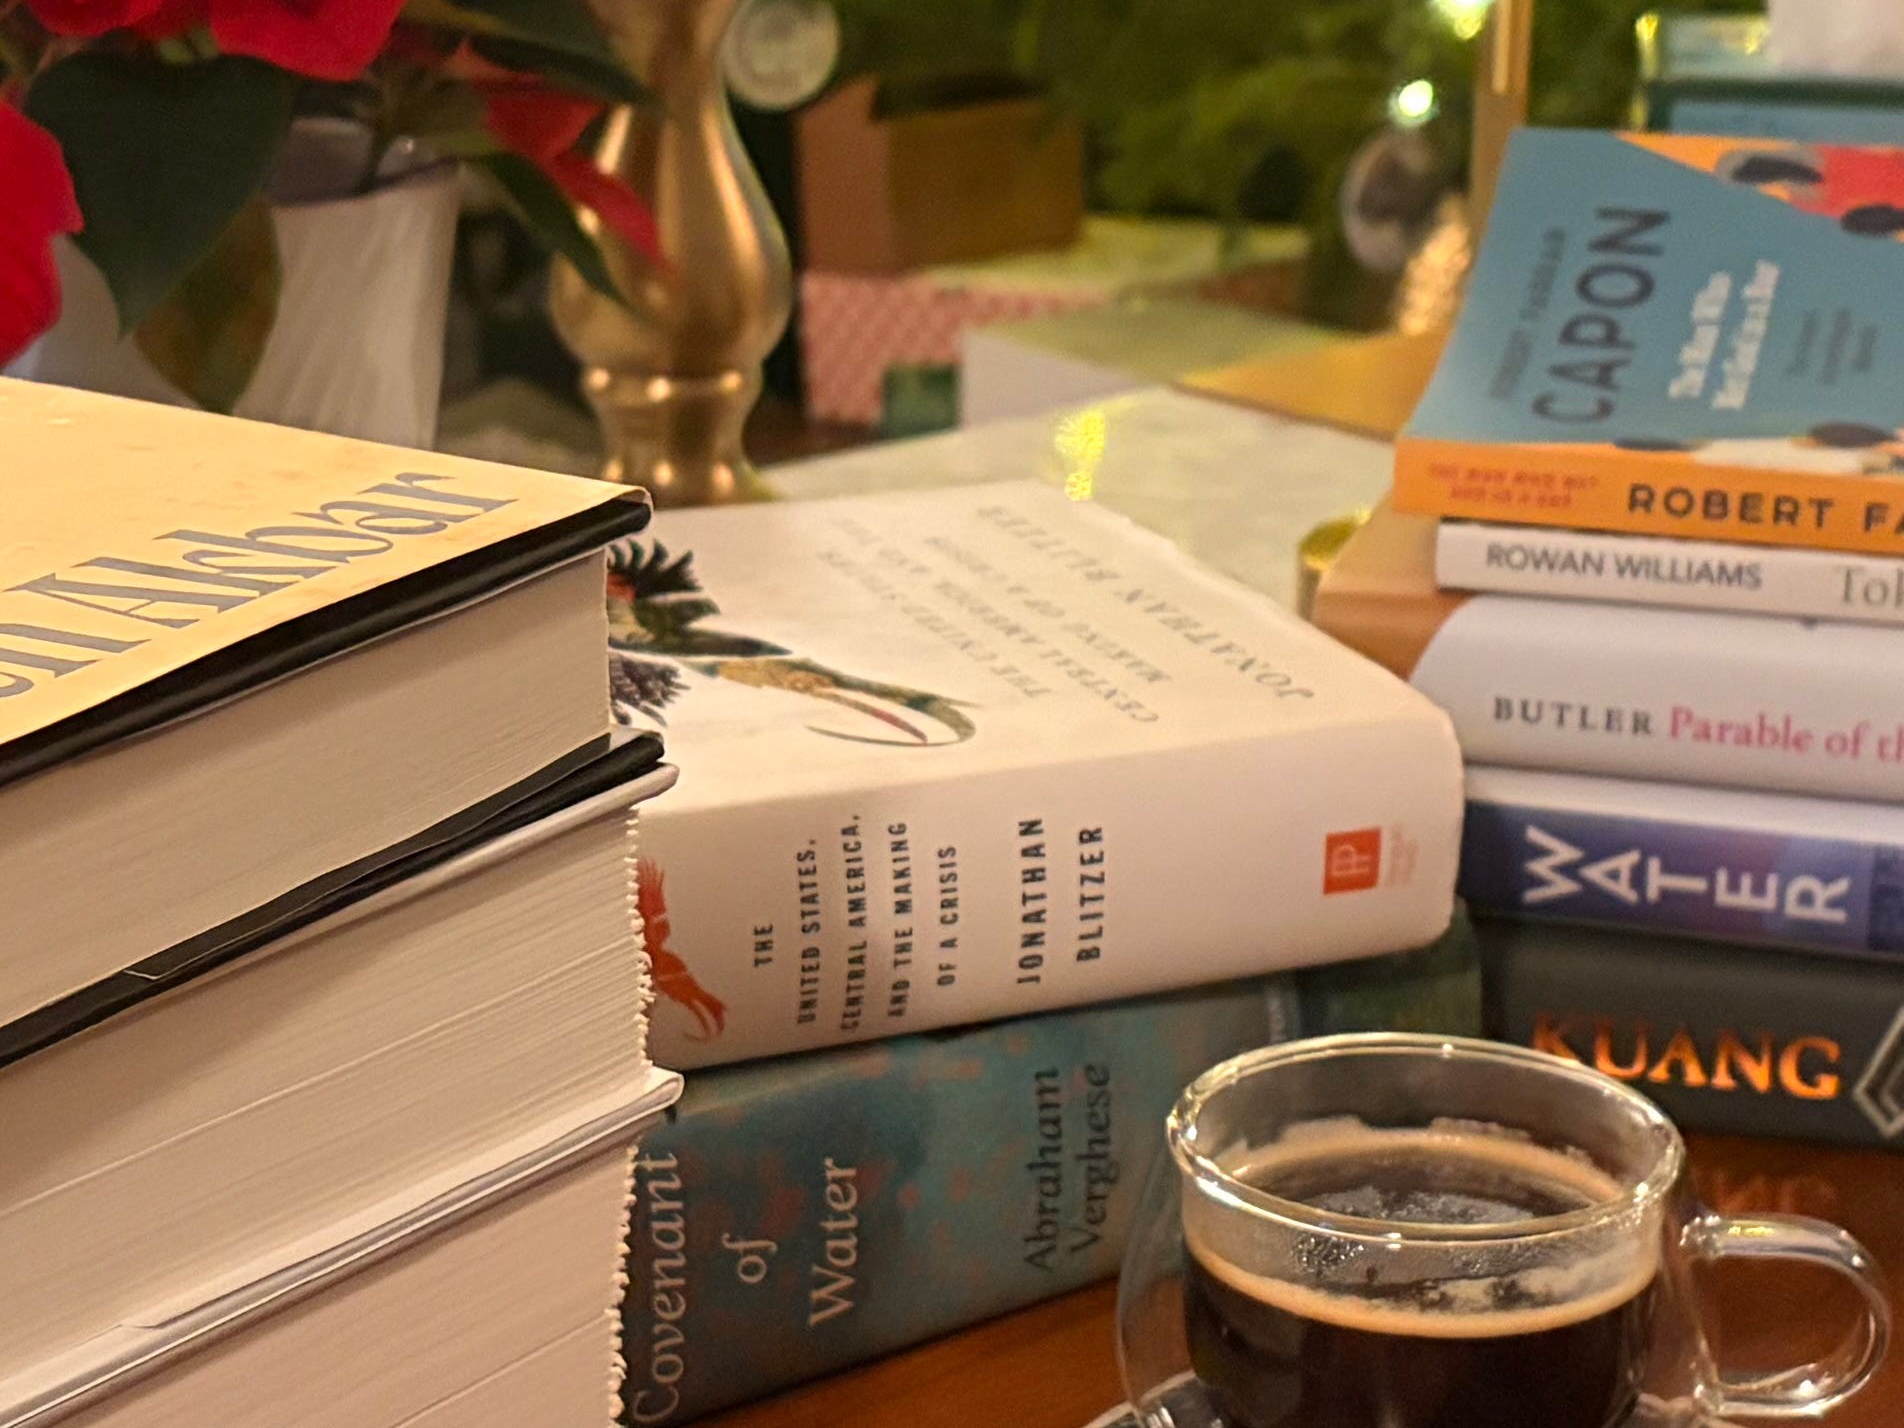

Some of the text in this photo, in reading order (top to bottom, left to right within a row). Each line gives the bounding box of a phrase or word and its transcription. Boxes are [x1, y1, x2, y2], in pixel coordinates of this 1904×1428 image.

[1532, 206, 1672, 424] CAPON
[3, 472, 519, 628] Akbar
[1485, 543, 1608, 574] ROWAN
[1613, 551, 1764, 591] WILLIAMS
[1627, 483, 1835, 531] ROBERT
[1493, 695, 1655, 738] BUTLER
[1667, 706, 1816, 757] Parable
[1823, 721, 1871, 761] of
[887, 821, 914, 1018] AND THE MAKING
[936, 845, 960, 988] OF A CRISIS
[1016, 818, 1047, 985] JONATHAN
[1076, 826, 1106, 963] BLITZER
[1522, 824, 1851, 925] WATER
[753, 923, 774, 968] THE
[797, 945, 821, 1025] UNITED
[840, 939, 868, 1032] CENTRAL
[1530, 1010, 1842, 1101] KUANG
[1023, 1066, 1065, 1273] Abraham
[1070, 1062, 1112, 1255] Verghese
[631, 1152, 687, 1424] Covenant
[722, 1231, 779, 1285] of
[807, 1156, 860, 1329] Water
